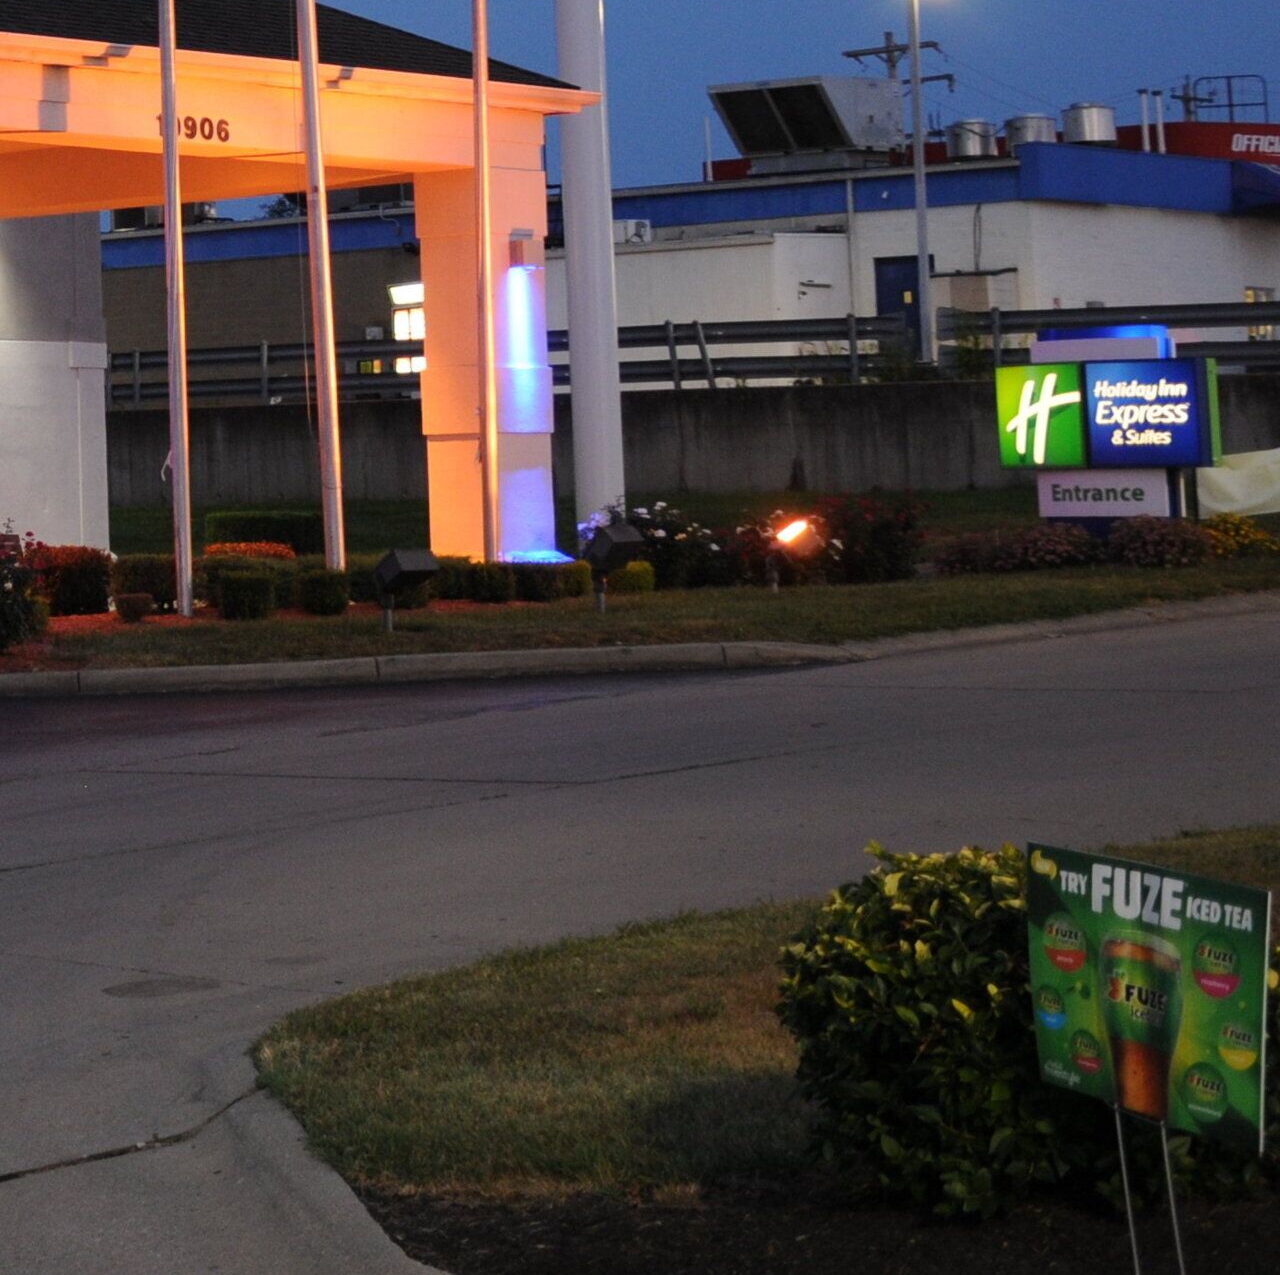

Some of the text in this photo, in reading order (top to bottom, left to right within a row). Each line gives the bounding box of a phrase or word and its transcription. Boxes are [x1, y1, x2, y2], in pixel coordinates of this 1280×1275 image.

[1093, 378, 1188, 401] Holiday Inn
[1095, 400, 1190, 430] Express
[1111, 428, 1172, 446] & Suites
[1051, 483, 1145, 503] Entrance
[1059, 862, 1253, 933] TRY FUZE ICED TEA
[1124, 983, 1166, 1012] FUZE
